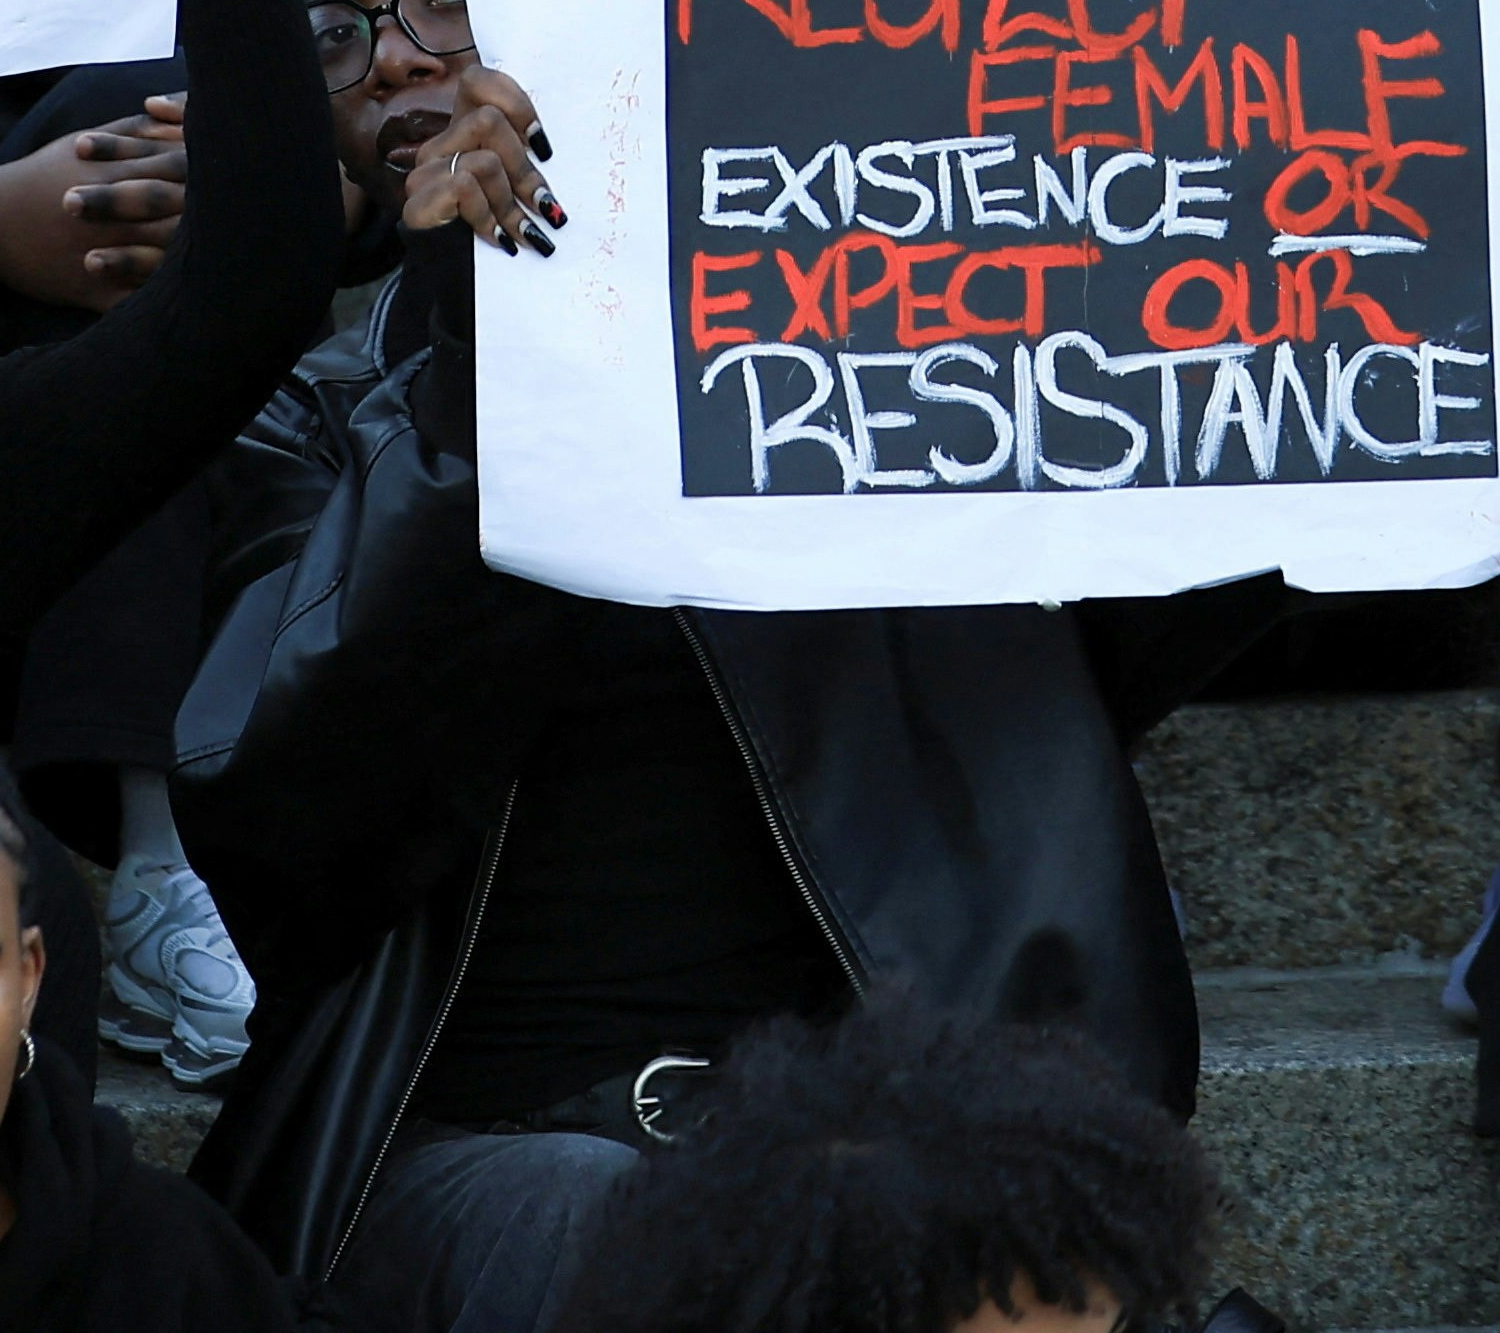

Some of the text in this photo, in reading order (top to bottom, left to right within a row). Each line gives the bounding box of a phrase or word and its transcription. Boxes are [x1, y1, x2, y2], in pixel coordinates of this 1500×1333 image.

[967, 30, 1466, 159] FEMALE
[699, 134, 1432, 245] EXISTENCE OR
[691, 231, 1420, 351] EXPECT OUR
[700, 330, 1494, 494] RESISTANCE
